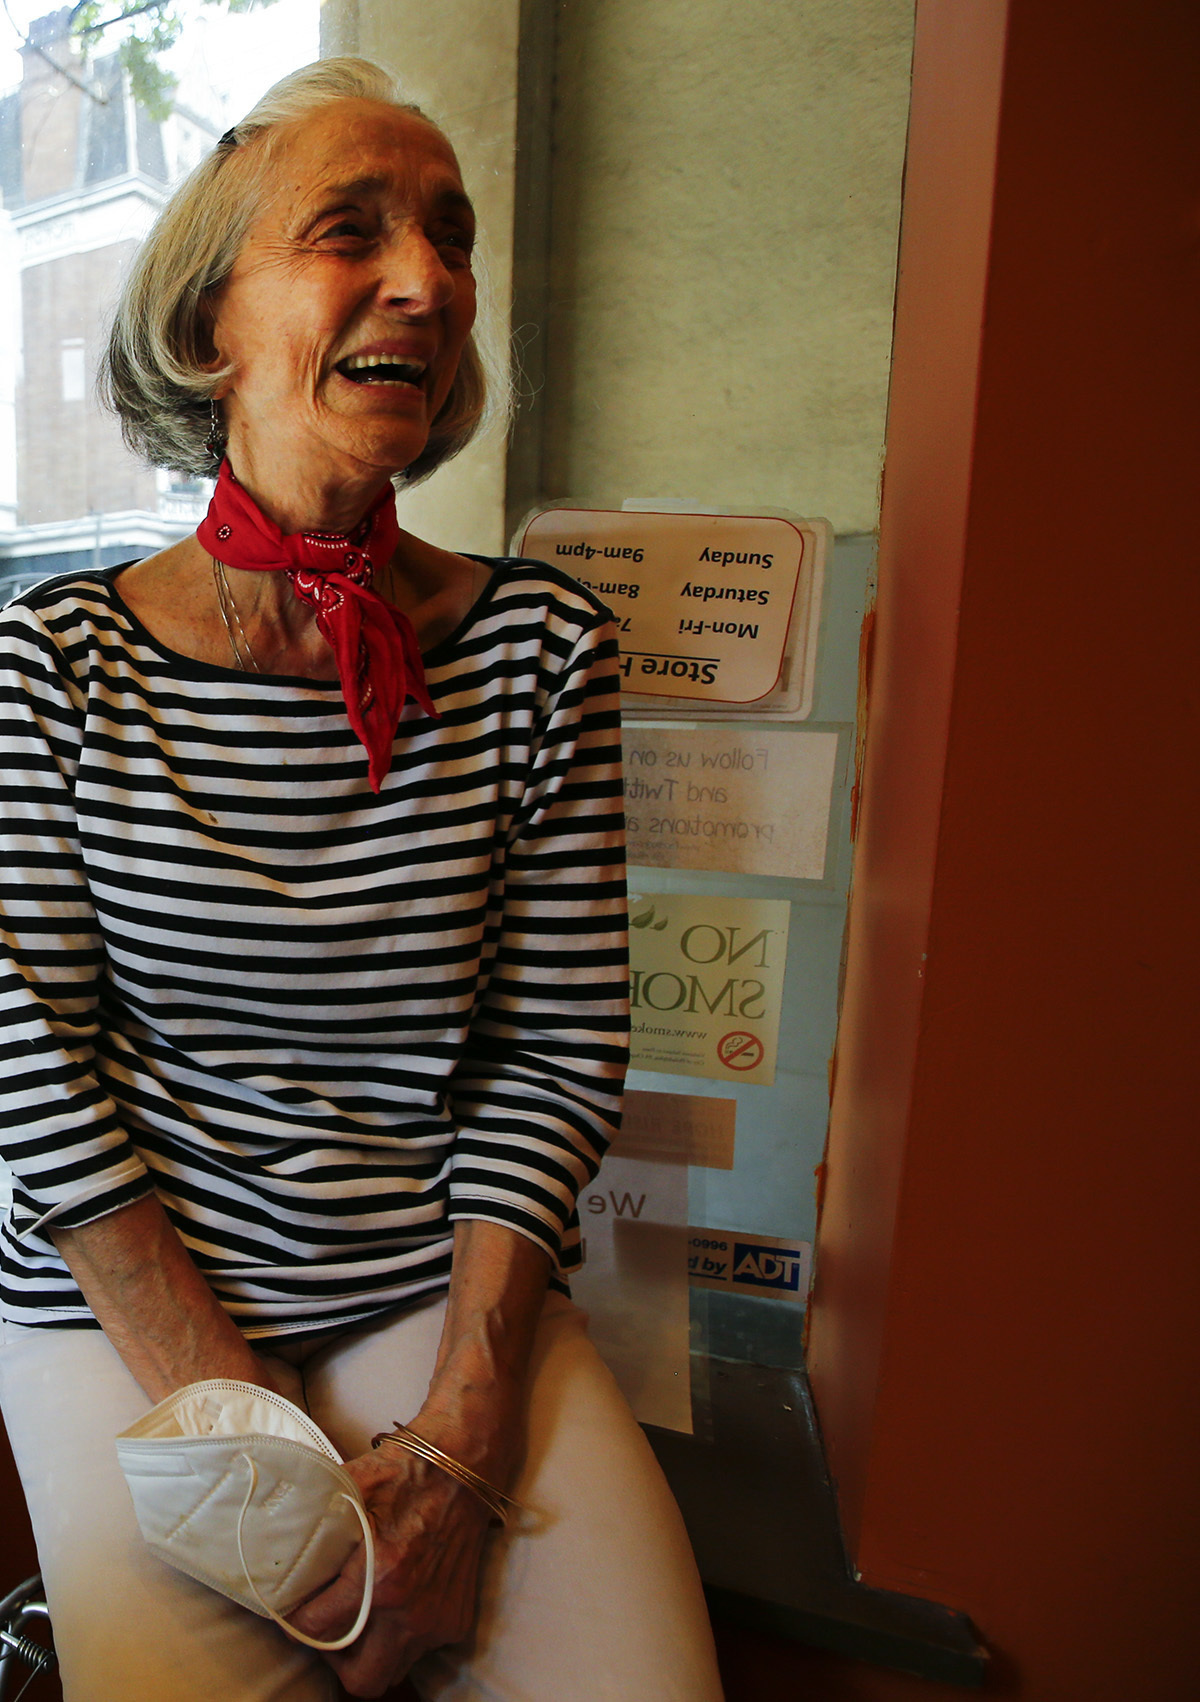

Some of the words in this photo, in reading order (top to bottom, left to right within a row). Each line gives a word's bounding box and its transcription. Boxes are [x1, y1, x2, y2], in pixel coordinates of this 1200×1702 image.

[556, 542, 645, 563] 9am-4pm
[699, 547, 774, 569] Sunday
[680, 582, 770, 605] Saturday
[678, 619, 759, 639] Mon-Fri
[641, 658, 718, 685] Store
[702, 1257, 728, 1275] by
[733, 1251, 800, 1283] ADT
